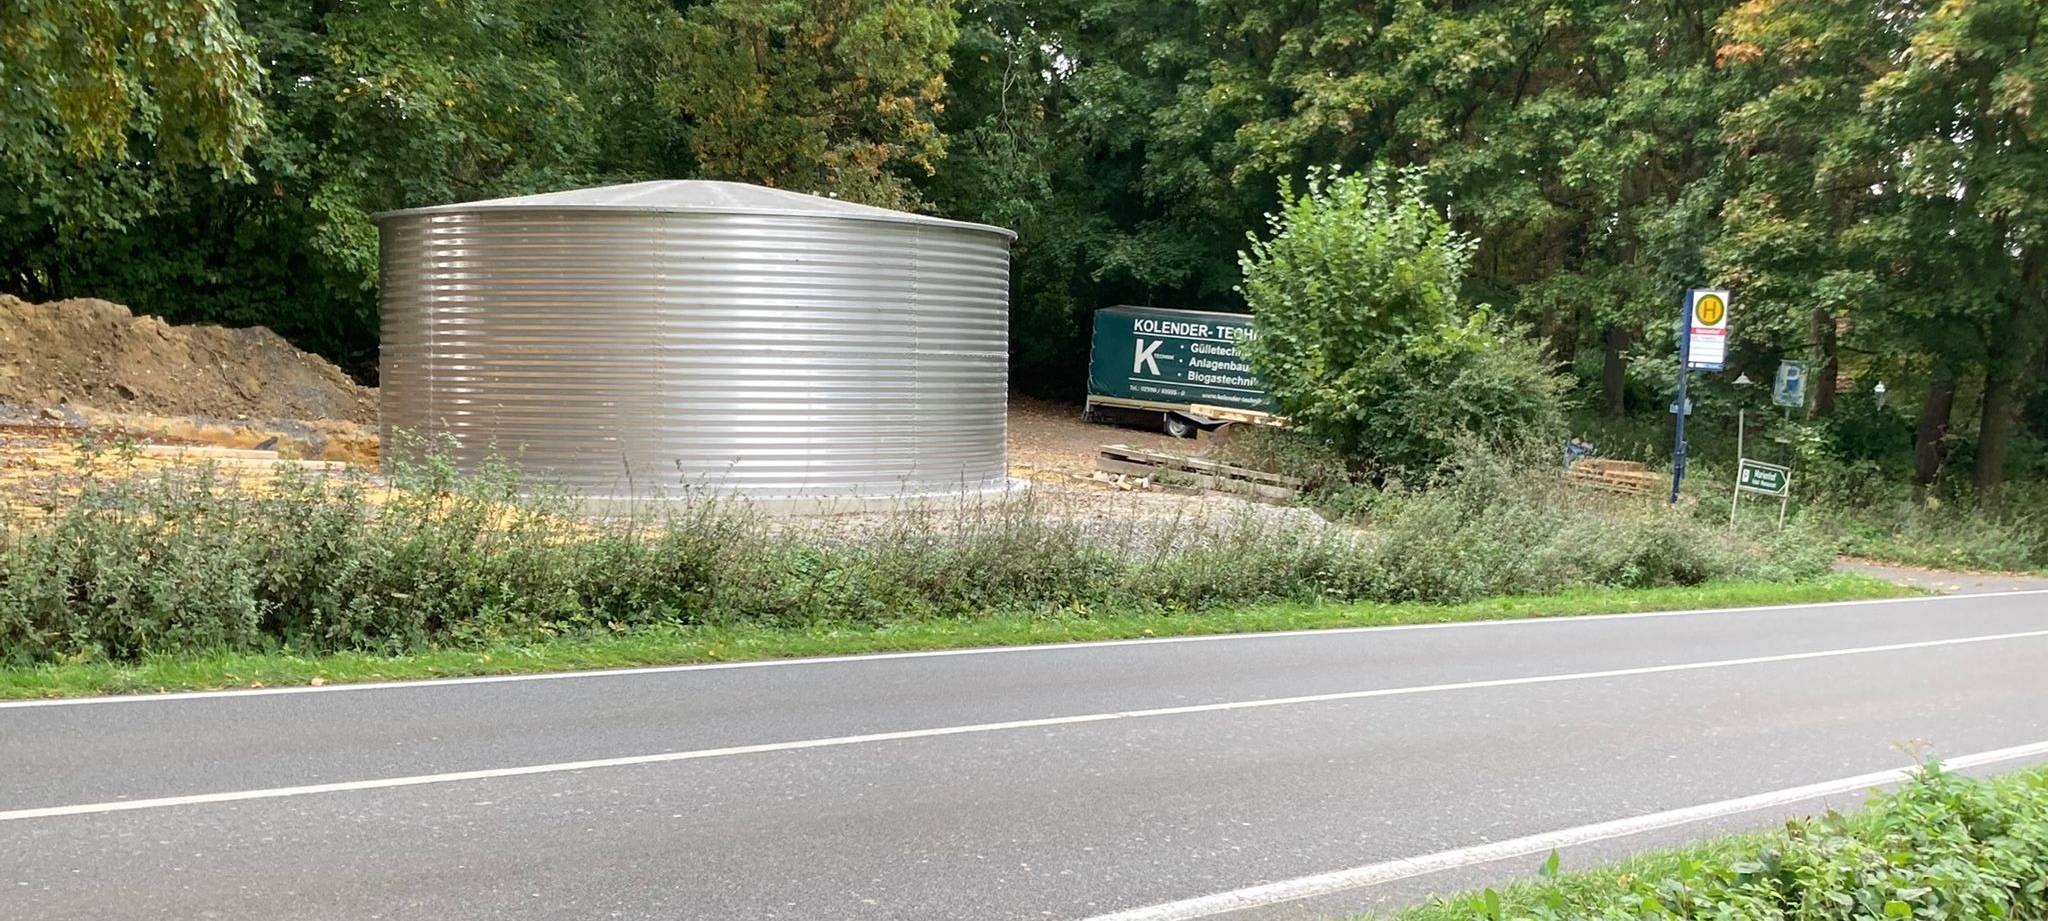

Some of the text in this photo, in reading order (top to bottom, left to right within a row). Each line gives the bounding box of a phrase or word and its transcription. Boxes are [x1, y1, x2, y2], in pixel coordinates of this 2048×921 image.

[1703, 300, 1717, 319] H
[1134, 319, 1213, 337] KOLENDER-
[1133, 338, 1164, 376] K
[1188, 357, 1249, 372] Anlagenbau
